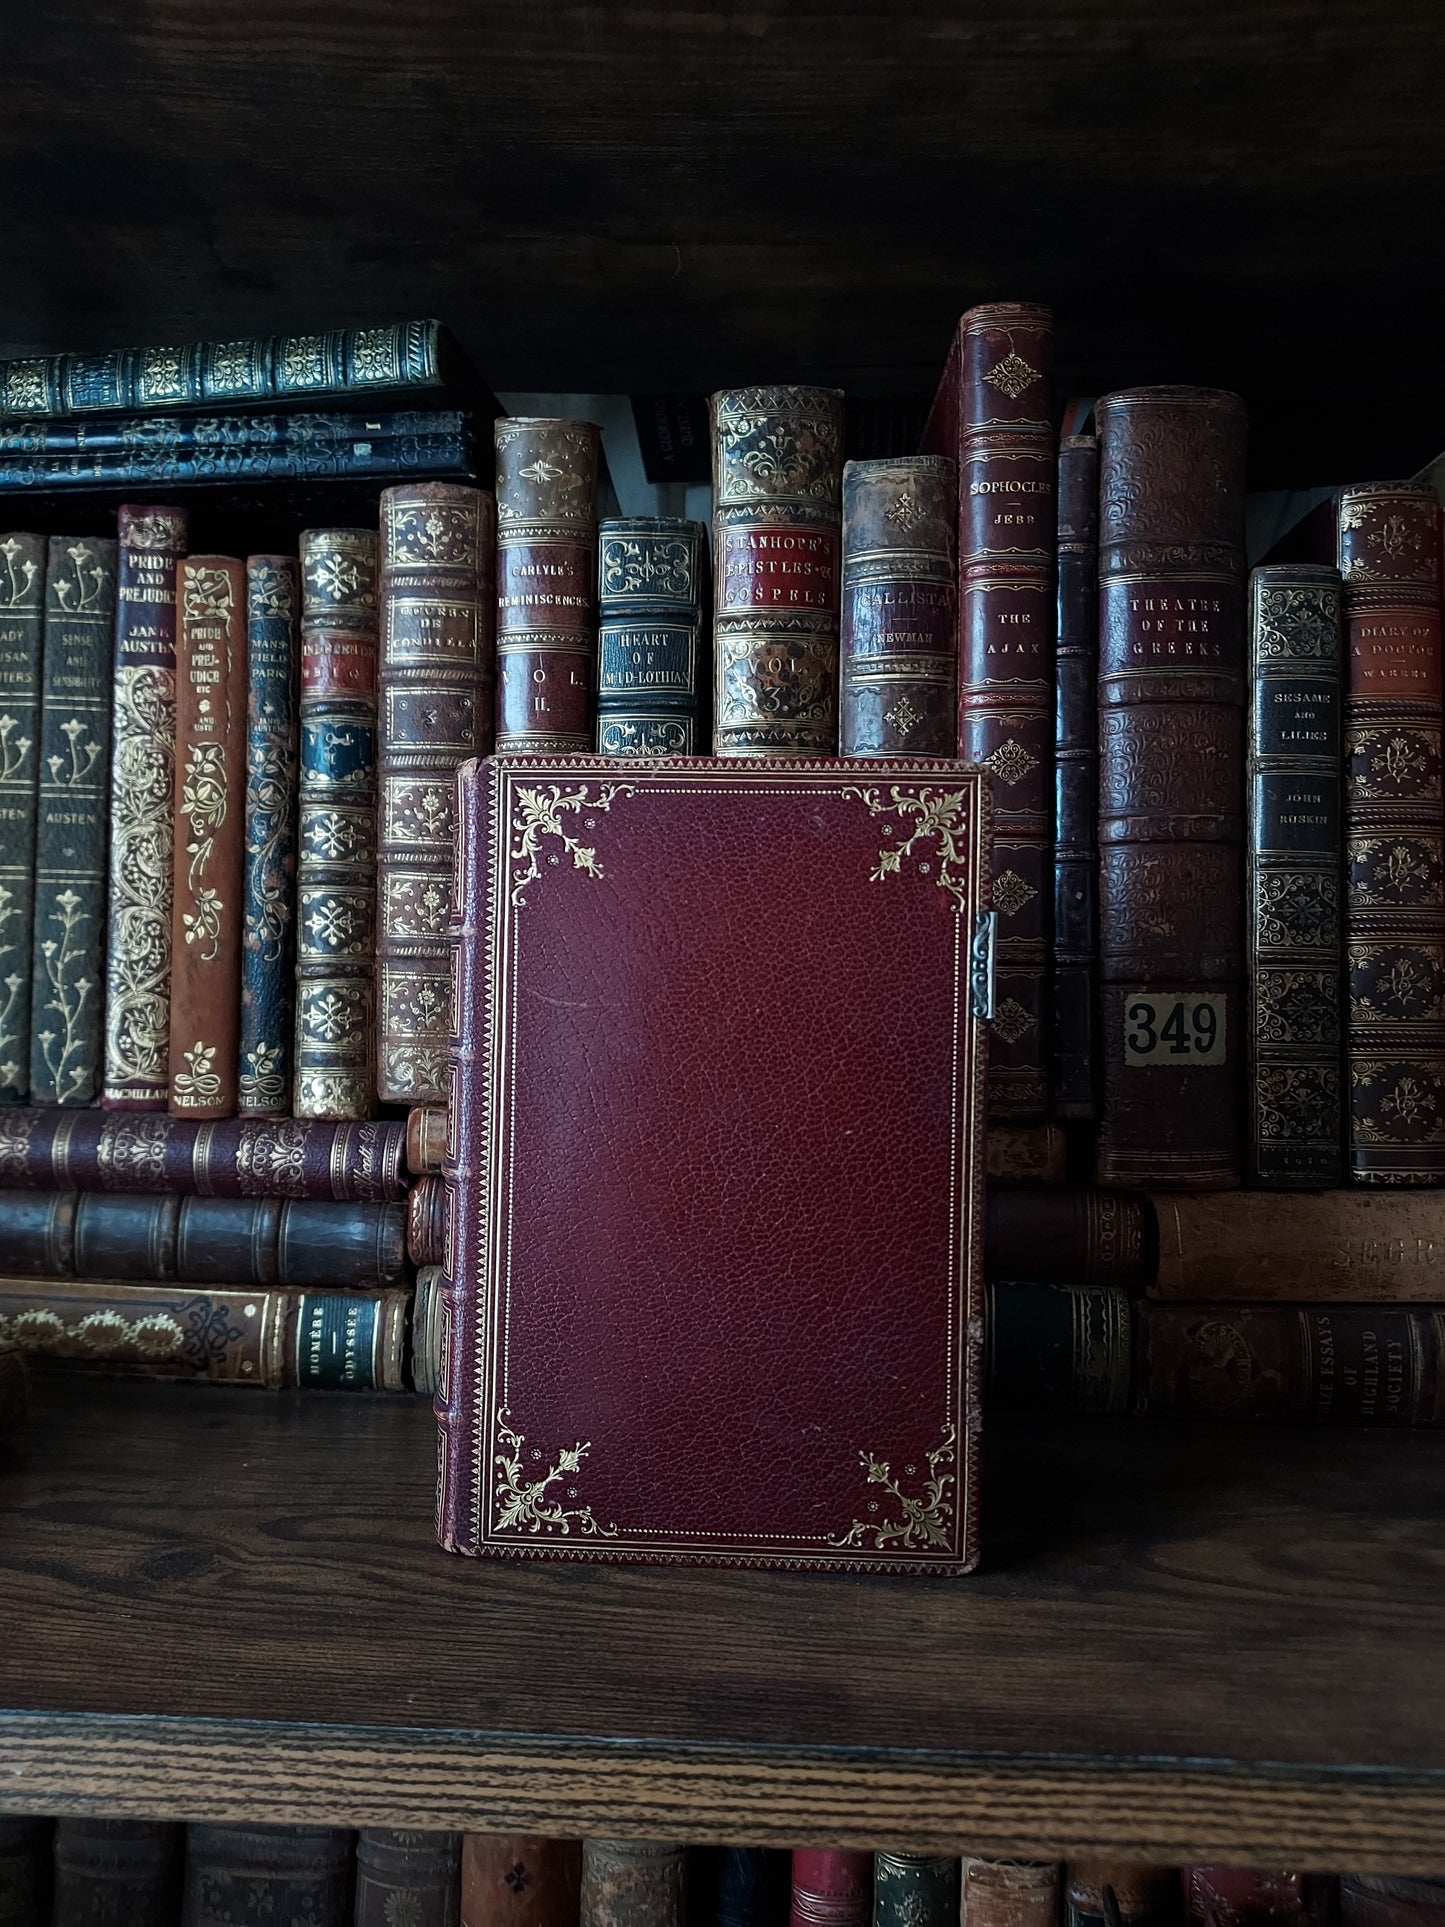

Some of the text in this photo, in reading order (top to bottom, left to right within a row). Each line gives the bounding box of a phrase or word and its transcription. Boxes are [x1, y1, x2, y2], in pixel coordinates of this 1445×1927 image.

[970, 481, 1051, 496] SOPHOCLES
[994, 514, 1035, 525] JEBB
[128, 554, 174, 570] PRIDE
[512, 561, 574, 577] CARLYLE'S
[725, 561, 812, 577] EPISTLES
[136, 573, 165, 585] AND
[726, 587, 826, 605] GOSPELS
[860, 592, 948, 608] CALLISTA
[1130, 598, 1220, 612] THEATRE
[420, 618, 441, 628] DE
[998, 614, 1031, 624] THE
[1142, 619, 1209, 633] OF THE
[1361, 626, 1409, 638] DIARY
[0, 630, 24, 642] ADY
[191, 627, 221, 640] PRIDE
[877, 632, 934, 644] NEWMAN
[62, 634, 93, 647] SENSE
[621, 634, 669, 647] HEART
[987, 643, 1040, 654] AJAX
[1132, 641, 1220, 656] GREEKS
[0, 651, 28, 663] USAN
[192, 654, 220, 667] PREJ-
[251, 653, 287, 663] FIELD
[632, 652, 654, 665] OF
[750, 657, 808, 675] VOL.
[0, 671, 33, 684] TERS
[190, 670, 220, 683] UDICE
[605, 671, 689, 685] MID-LOTHIAN
[197, 685, 211, 693] ETC
[534, 697, 550, 711] II.
[1274, 694, 1331, 703] SESAME
[0, 808, 26, 820] TEN
[46, 813, 95, 824] AUSTEN
[1129, 1003, 1216, 1054] 349
[104, 1088, 168, 1100] MACMILLAN
[174, 1096, 225, 1107] NELSON
[239, 1096, 286, 1107] NELSON
[309, 1307, 324, 1375] HOMÈRE
[344, 1307, 358, 1379] ODYSSÉE
[1317, 1316, 1335, 1375] ESSAYS
[1344, 1365, 1358, 1385] OF
[1361, 1330, 1378, 1415] HIGHLAND
[1386, 1338, 1402, 1413] SOCIETY
